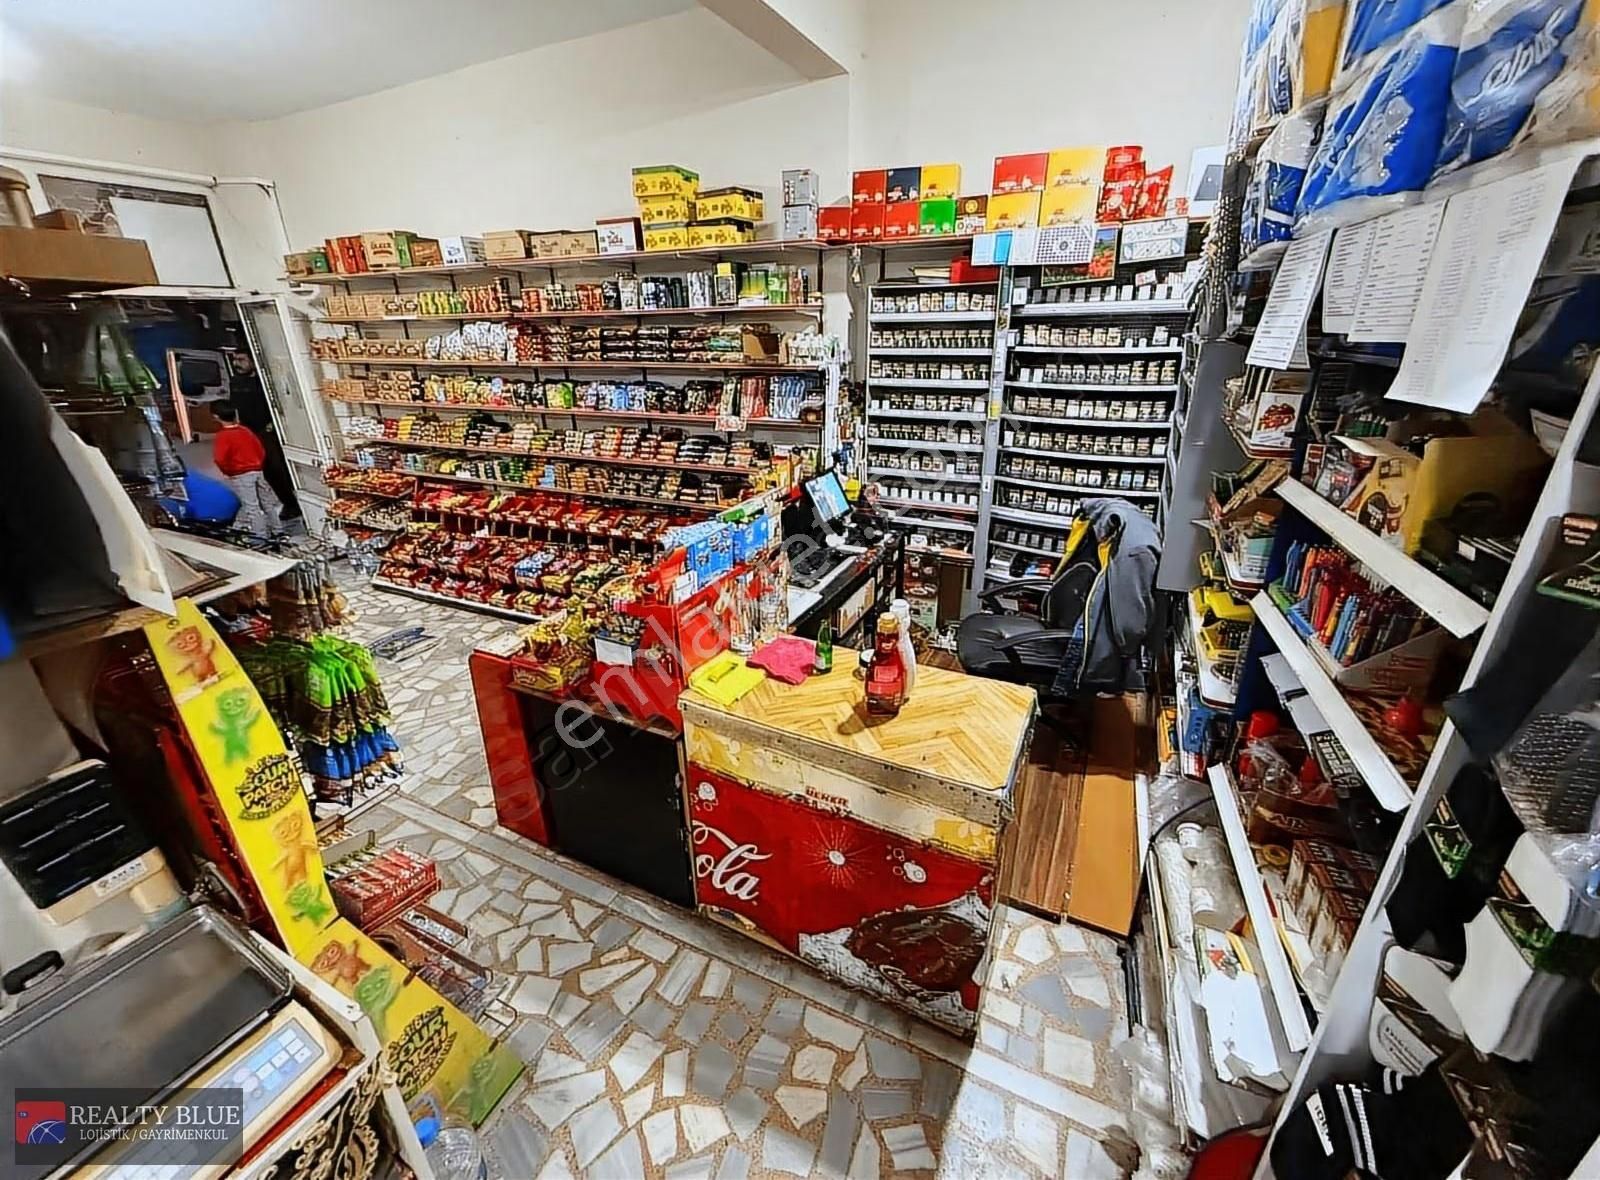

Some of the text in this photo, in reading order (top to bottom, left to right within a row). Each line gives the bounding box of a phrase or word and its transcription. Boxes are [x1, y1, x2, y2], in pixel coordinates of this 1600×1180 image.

[236, 761, 289, 793] SOUR
[242, 771, 294, 808] PATCH
[398, 1025, 448, 1084] ATCH
